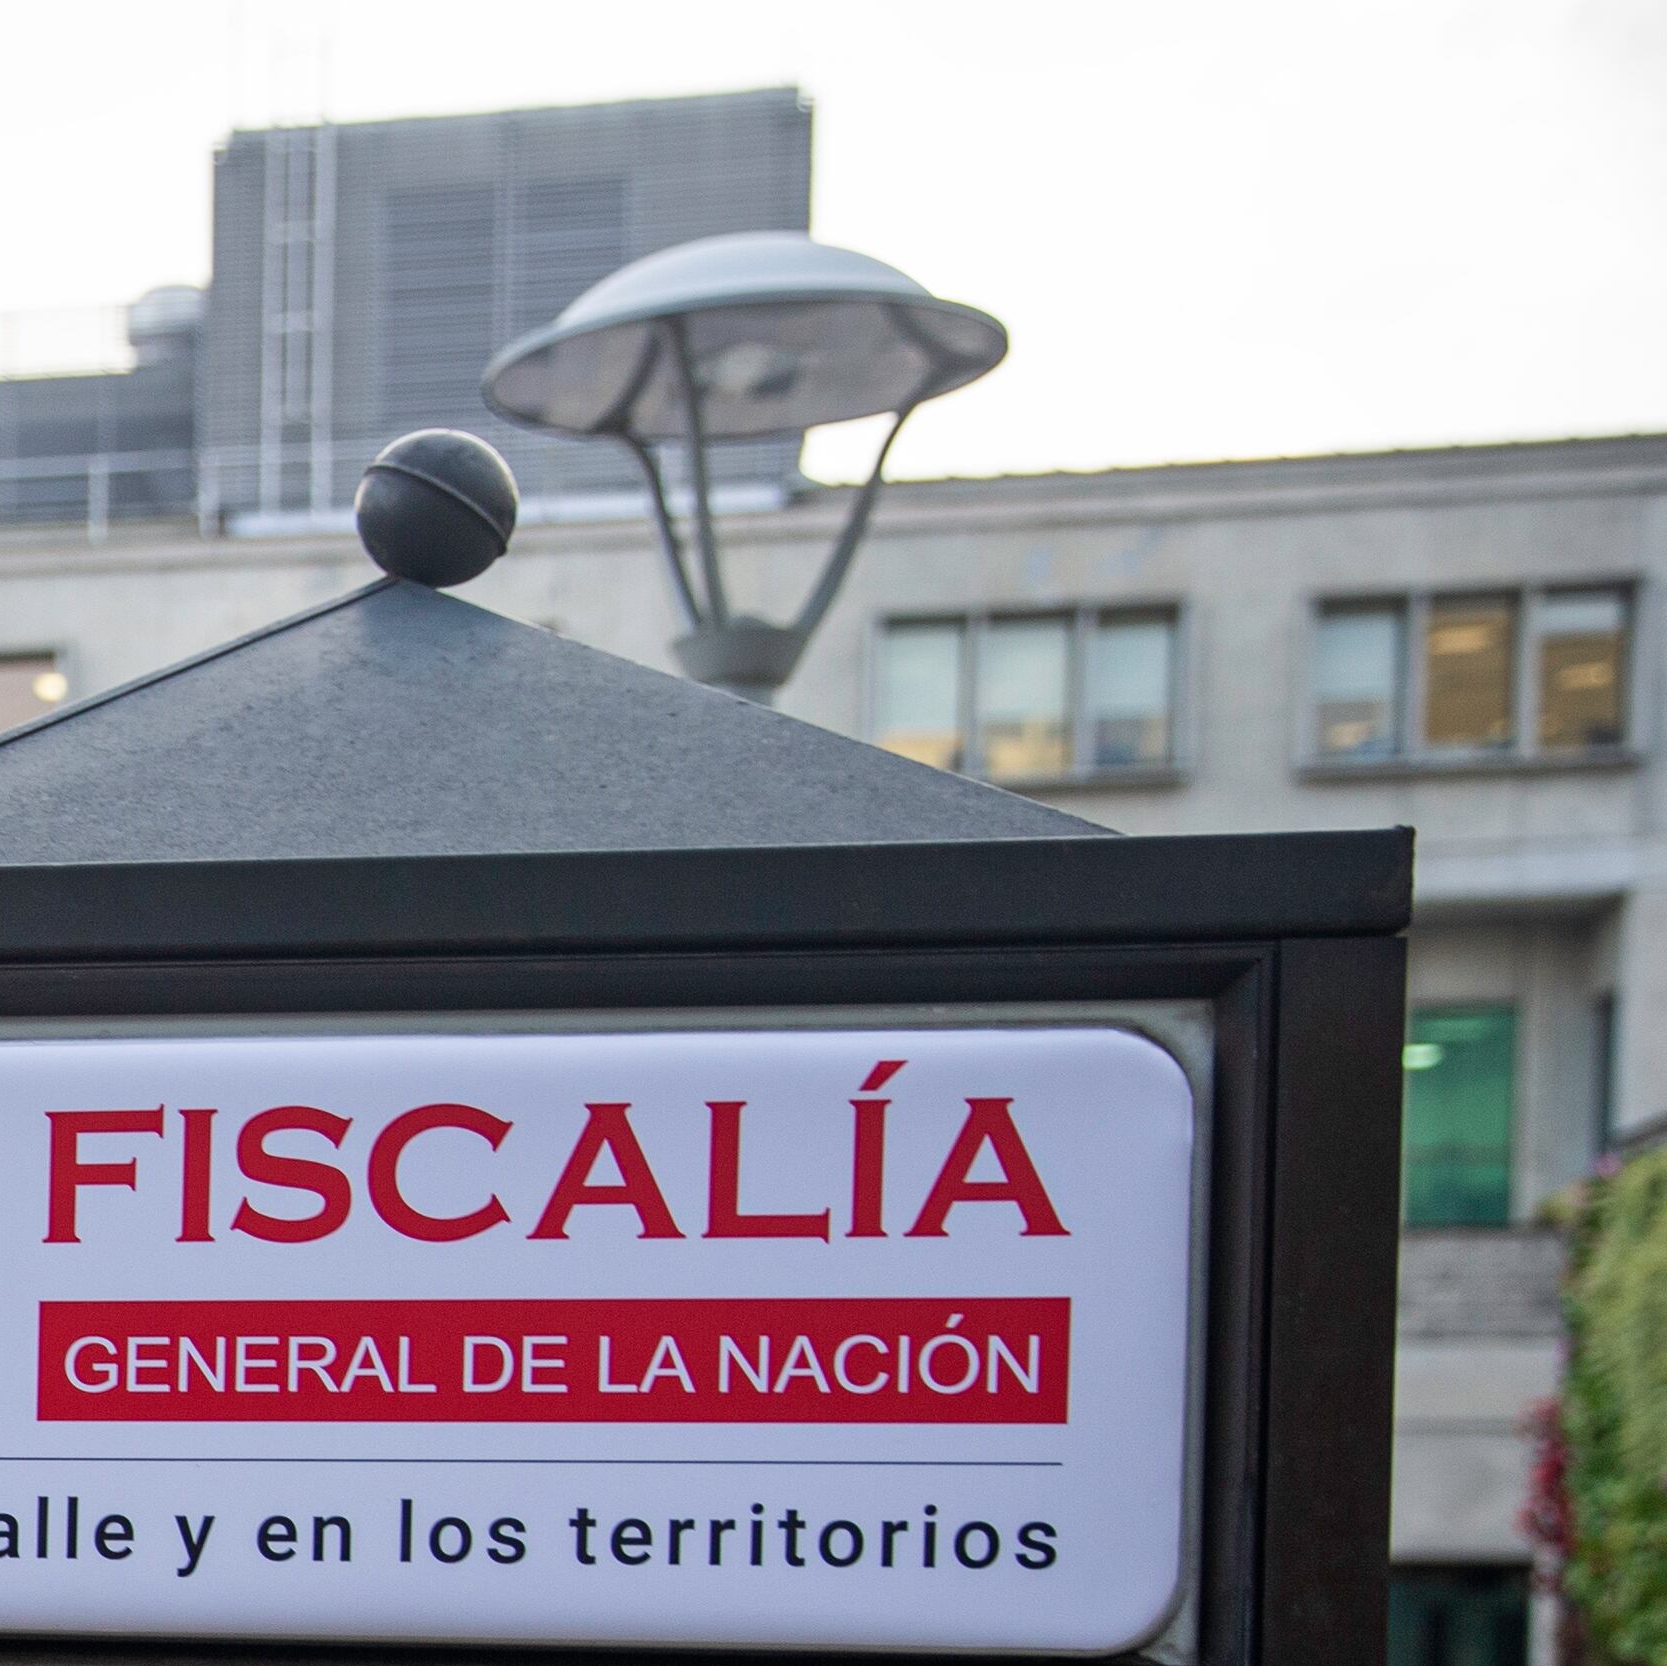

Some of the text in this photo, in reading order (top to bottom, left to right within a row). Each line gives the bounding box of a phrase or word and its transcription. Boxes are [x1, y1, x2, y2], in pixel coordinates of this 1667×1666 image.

[42, 1059, 1070, 1244] FISCALÍA
[63, 1313, 1040, 1394] GENERAL DE LA NACIÓN
[174, 1515, 216, 1578] y
[256, 1515, 352, 1562] en
[399, 1498, 526, 1565] los
[568, 1503, 1058, 1571] territorios
